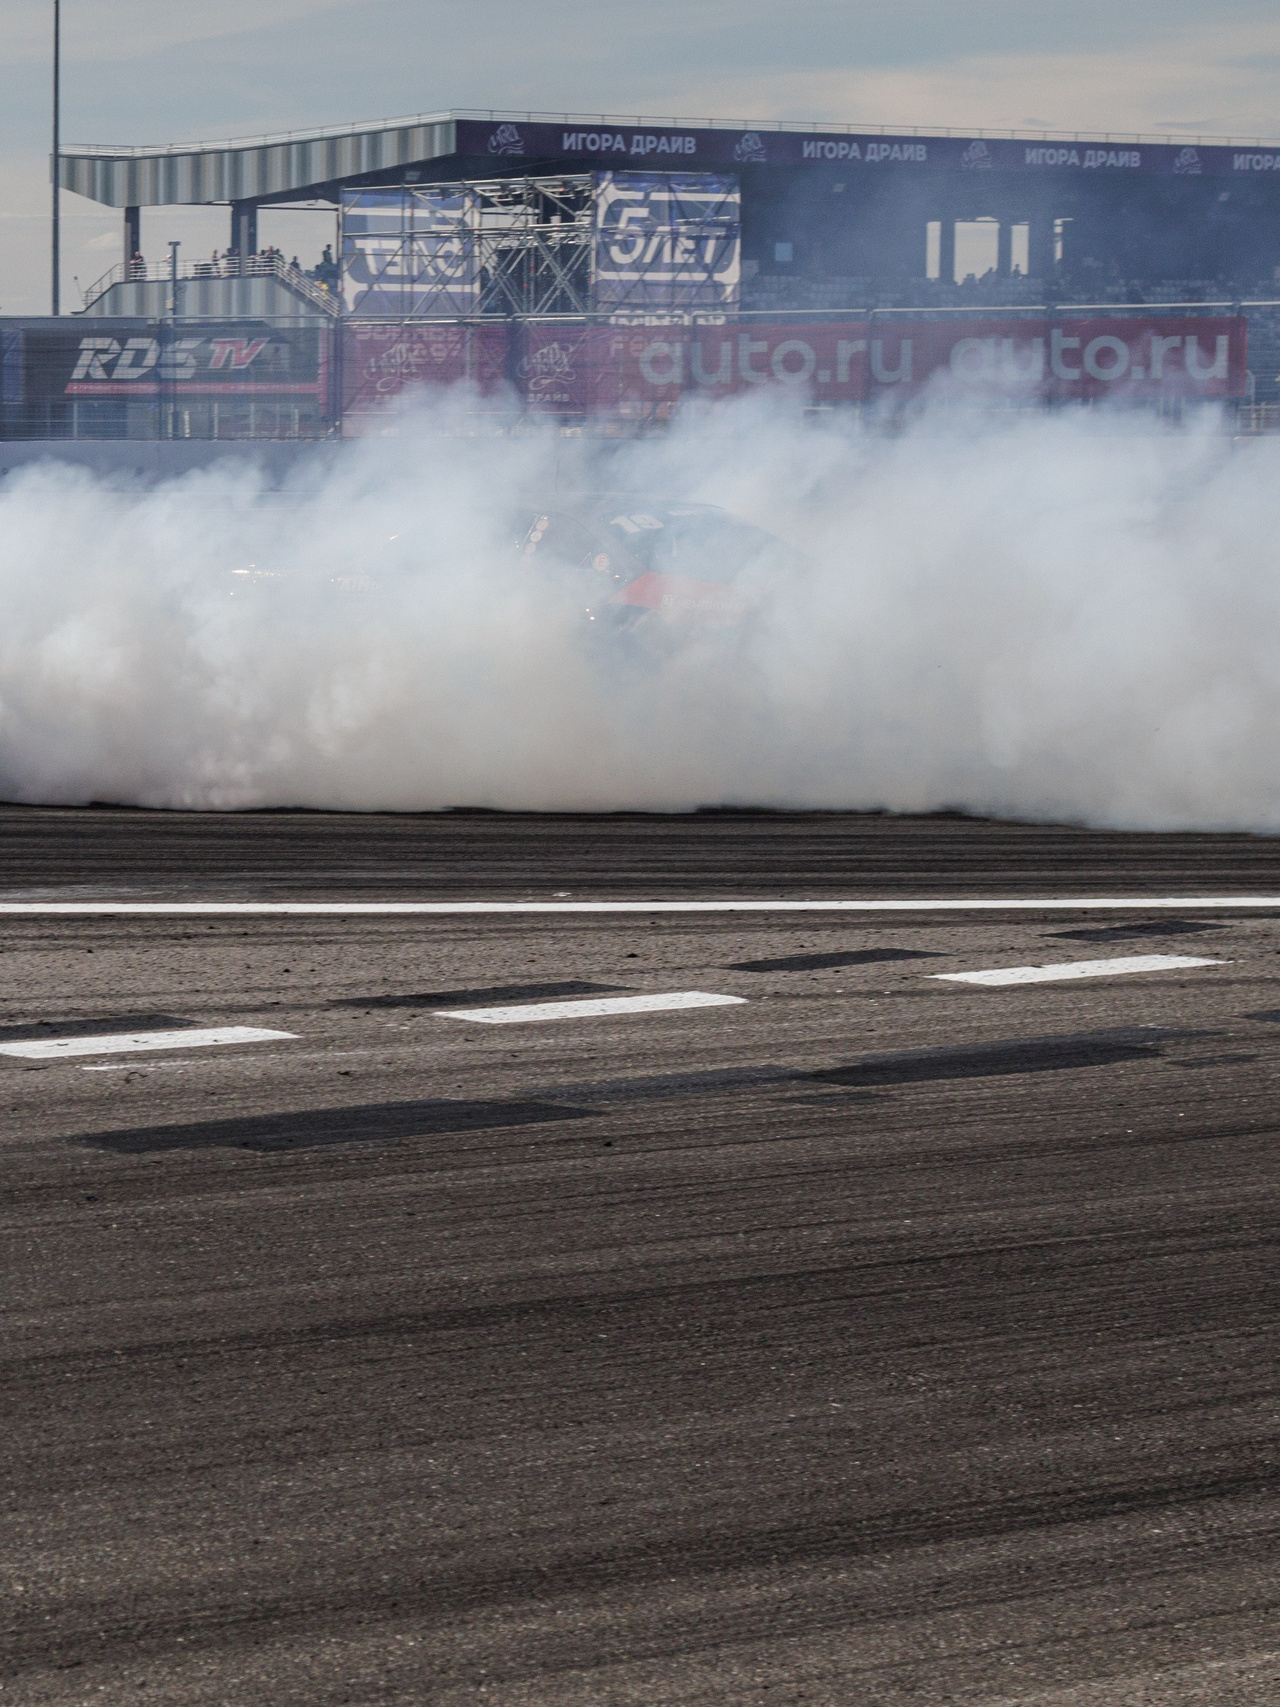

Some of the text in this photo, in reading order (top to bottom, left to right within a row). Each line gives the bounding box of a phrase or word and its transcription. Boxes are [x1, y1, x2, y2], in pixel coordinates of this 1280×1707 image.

[562, 132, 626, 152] ИГОРА
[803, 140, 862, 160] ИГОРА
[1025, 148, 1080, 166] ИГОРА
[71, 337, 271, 380] RDS TV
[639, 333, 913, 385] auto.ru
[950, 328, 1229, 381] auto.ru
